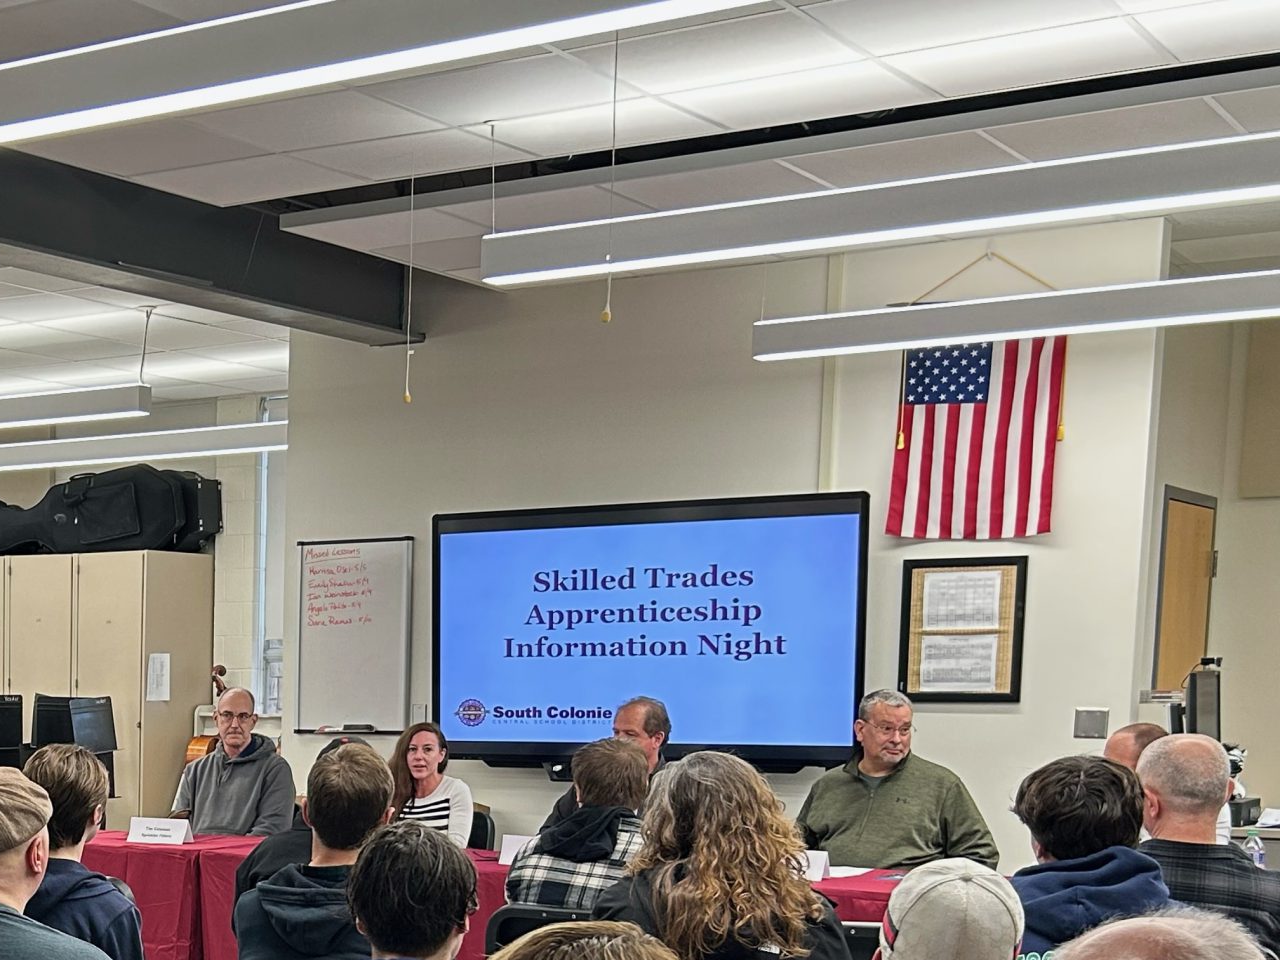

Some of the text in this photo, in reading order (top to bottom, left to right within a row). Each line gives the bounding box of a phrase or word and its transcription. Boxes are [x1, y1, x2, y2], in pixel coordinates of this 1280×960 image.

[533, 564, 754, 592] Skilled Trades
[524, 598, 762, 630] Apprenticeship
[503, 633, 787, 661] Information Night
[493, 706, 542, 718] South
[546, 706, 613, 718] Colonie
